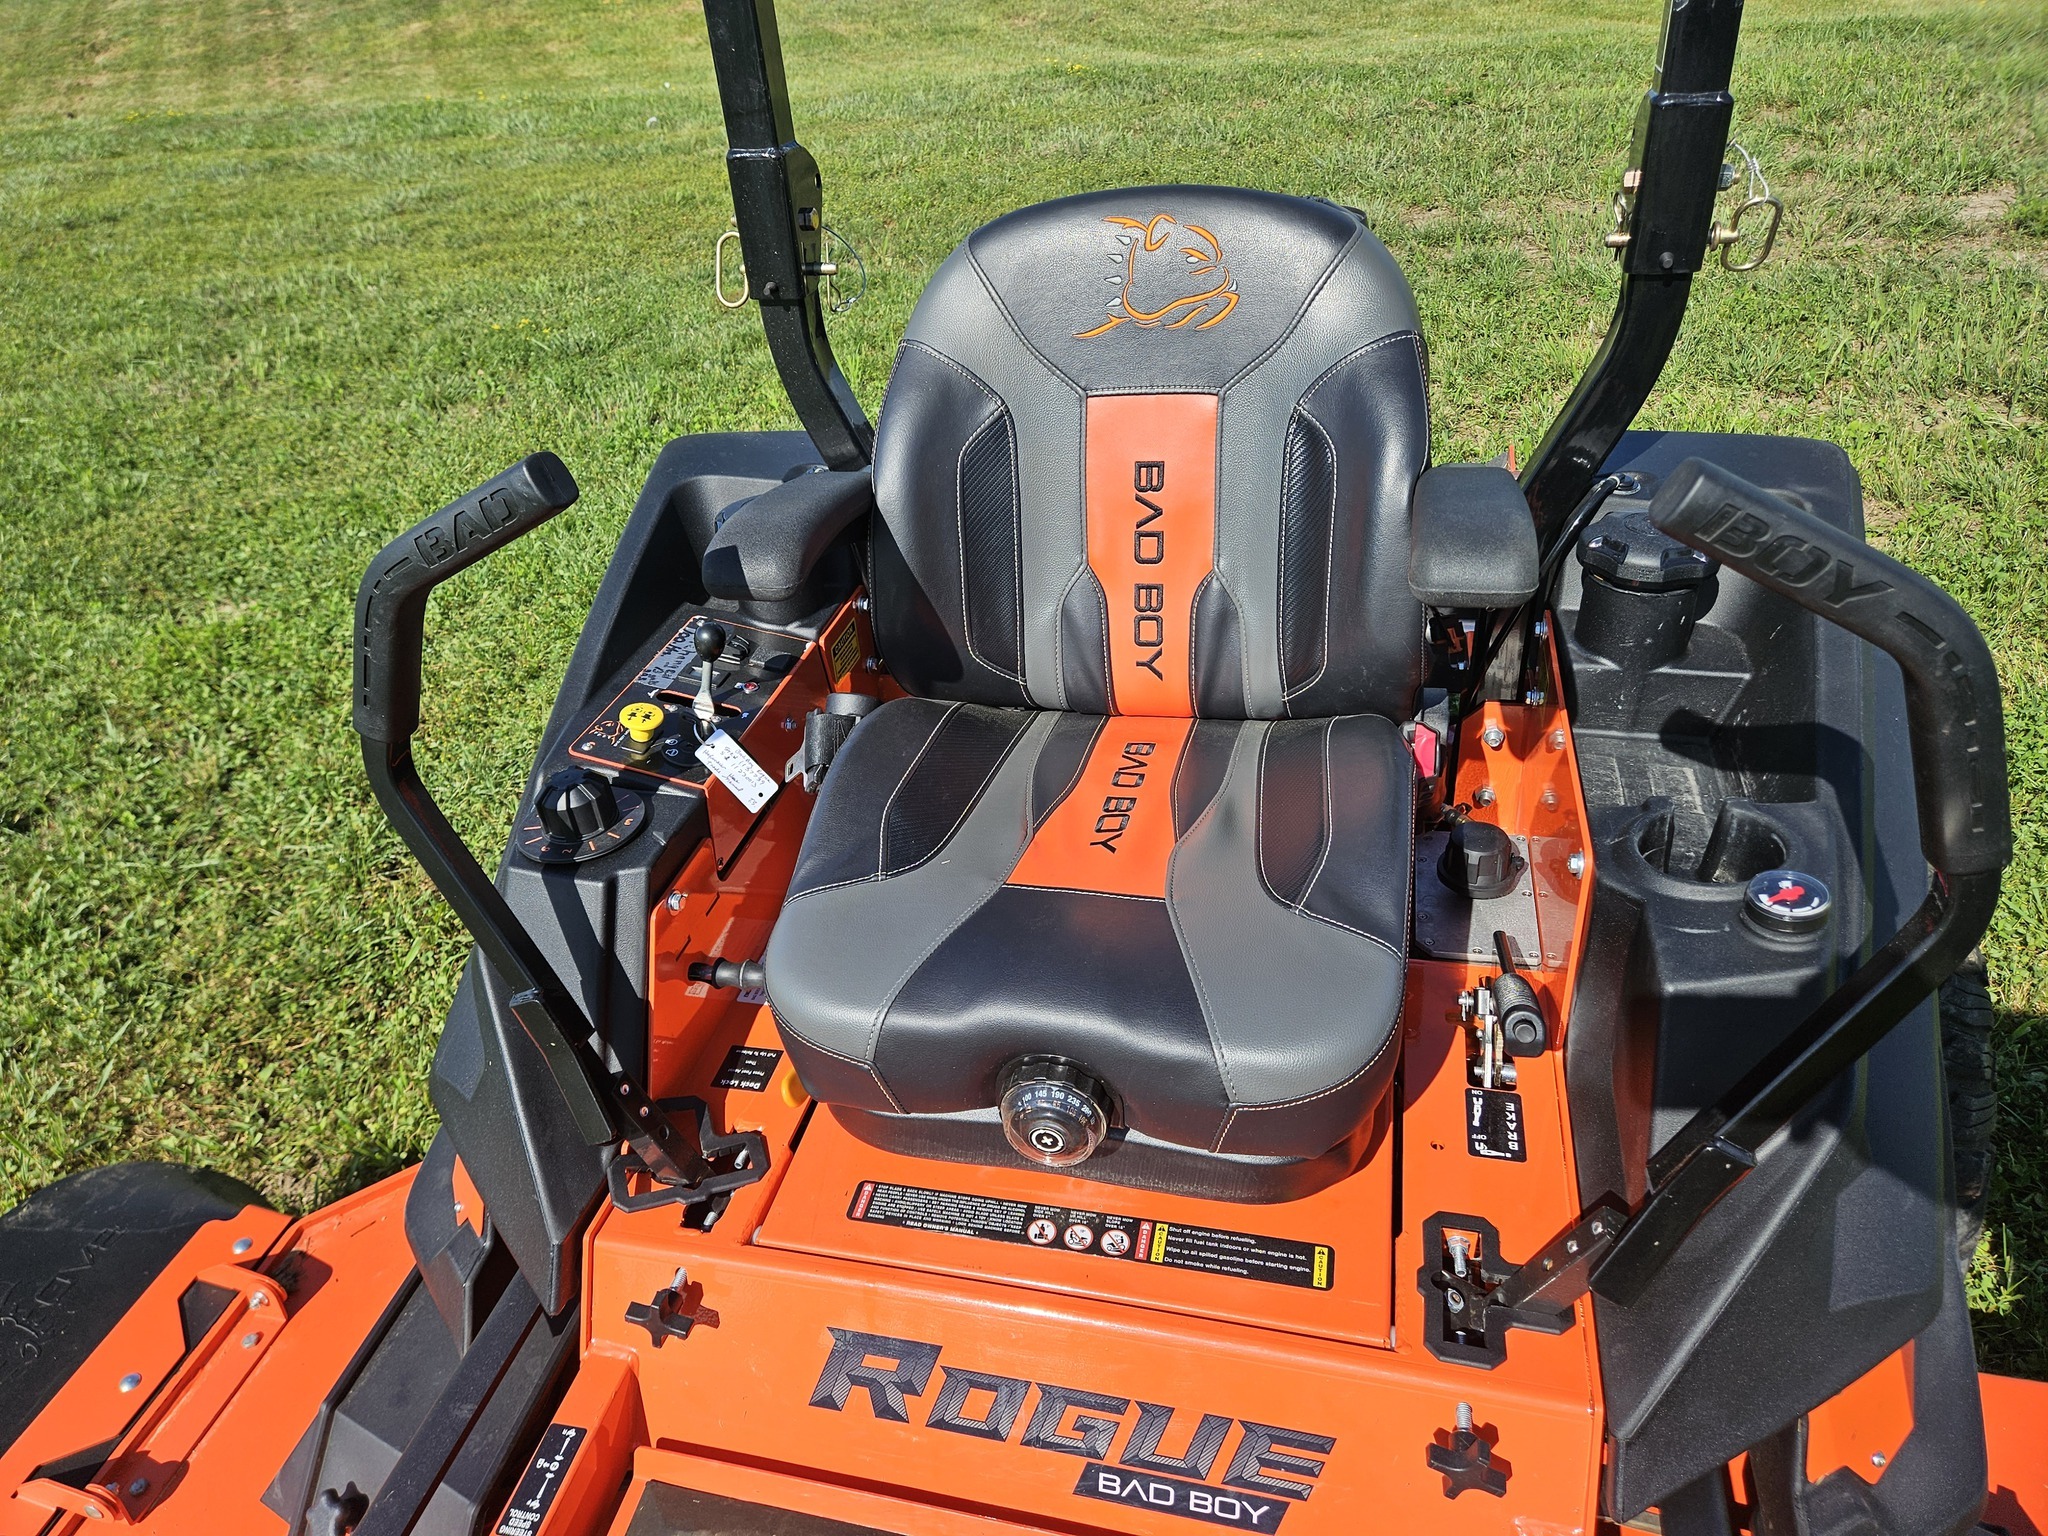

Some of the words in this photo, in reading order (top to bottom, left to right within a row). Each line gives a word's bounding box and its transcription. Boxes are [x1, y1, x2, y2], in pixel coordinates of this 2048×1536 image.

[1134, 461, 1164, 564] BAD
[414, 487, 521, 568] BAD
[1694, 502, 1896, 608] BOY
[1134, 583, 1164, 682] BOY
[1111, 742, 1156, 788] BAD
[1090, 796, 1138, 854] BOY
[740, 1080, 761, 1089] Deck
[1051, 1090, 1064, 1099] 190
[1067, 1095, 1081, 1107] 235
[1505, 1102, 1519, 1151] BRAKE
[1138, 1230, 1148, 1258] DANGER
[1154, 1232, 1163, 1260] CAUTION
[1230, 1235, 1257, 1244] refueling.
[1219, 1254, 1244, 1263] gasoline
[1265, 1261, 1288, 1270] starting
[1289, 1265, 1311, 1273] engine.
[1221, 1265, 1249, 1275] refueling.
[808, 1326, 1338, 1502] ROGUE
[1098, 1470, 1174, 1506] BAD
[1190, 1492, 1270, 1524] BOY
[508, 1518, 532, 1529] SPEED
[510, 1508, 540, 1522] CONTROL
[498, 1525, 532, 1536] STEERING
